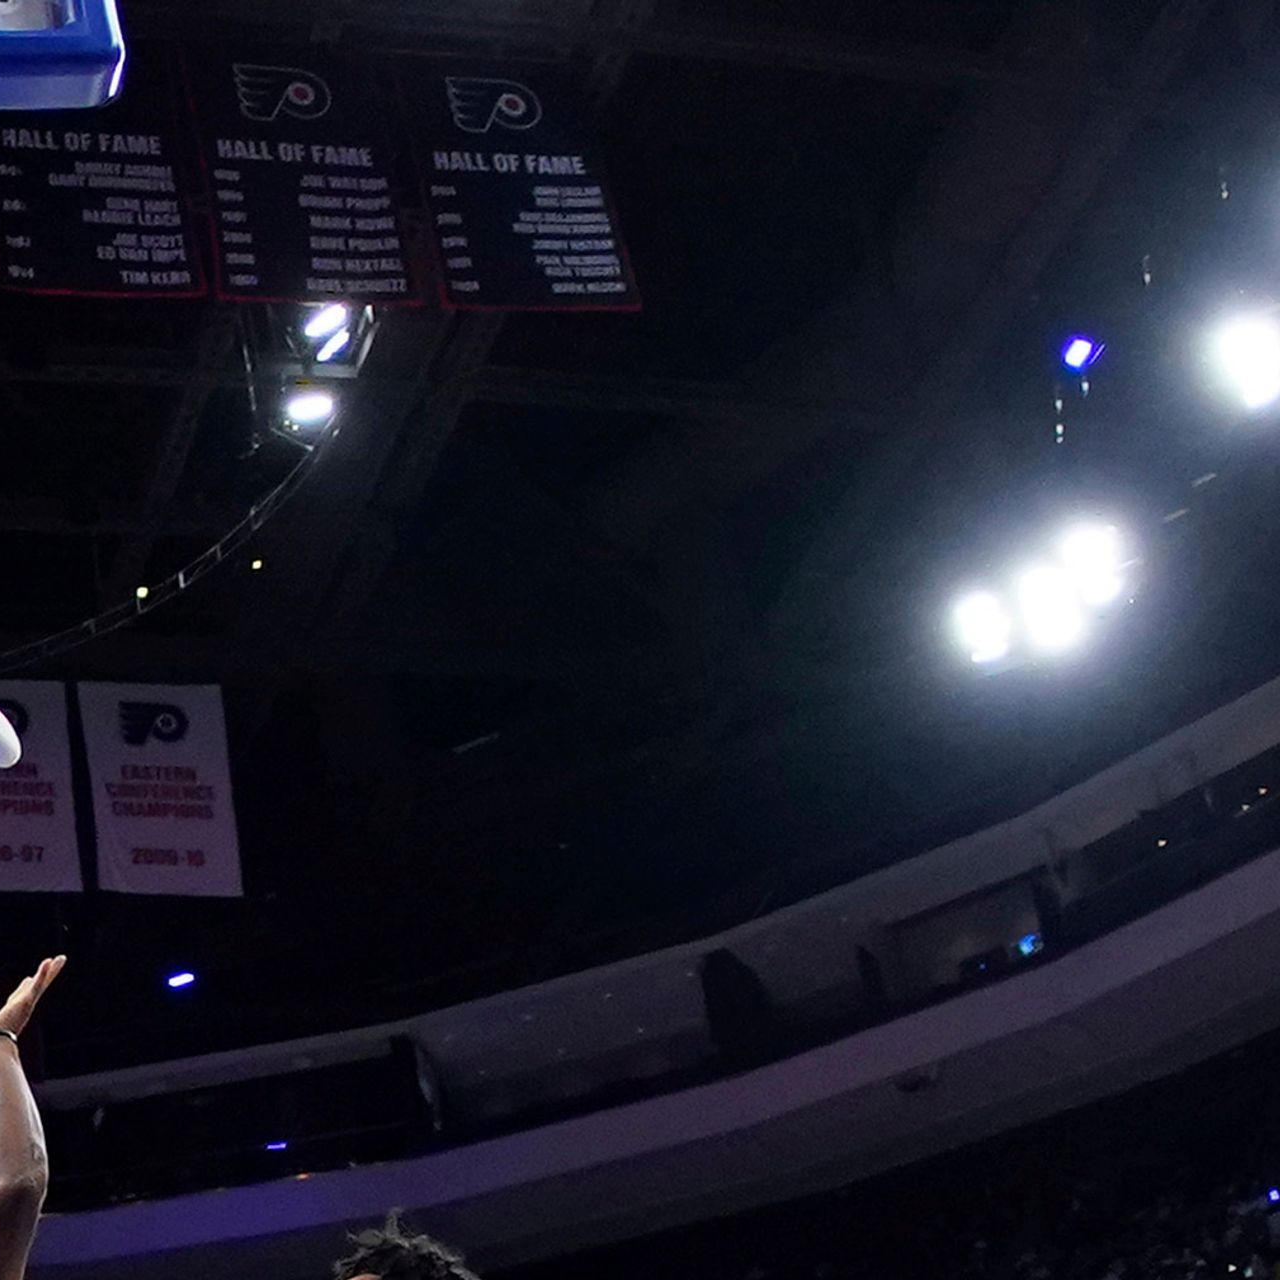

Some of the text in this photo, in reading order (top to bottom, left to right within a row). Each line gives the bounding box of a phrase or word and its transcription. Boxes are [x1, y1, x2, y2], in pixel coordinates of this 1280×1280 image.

[1, 128, 162, 155] HALL OF FAME
[217, 139, 374, 167] HALL OF FAME
[433, 151, 588, 175] HALL OF FAME
